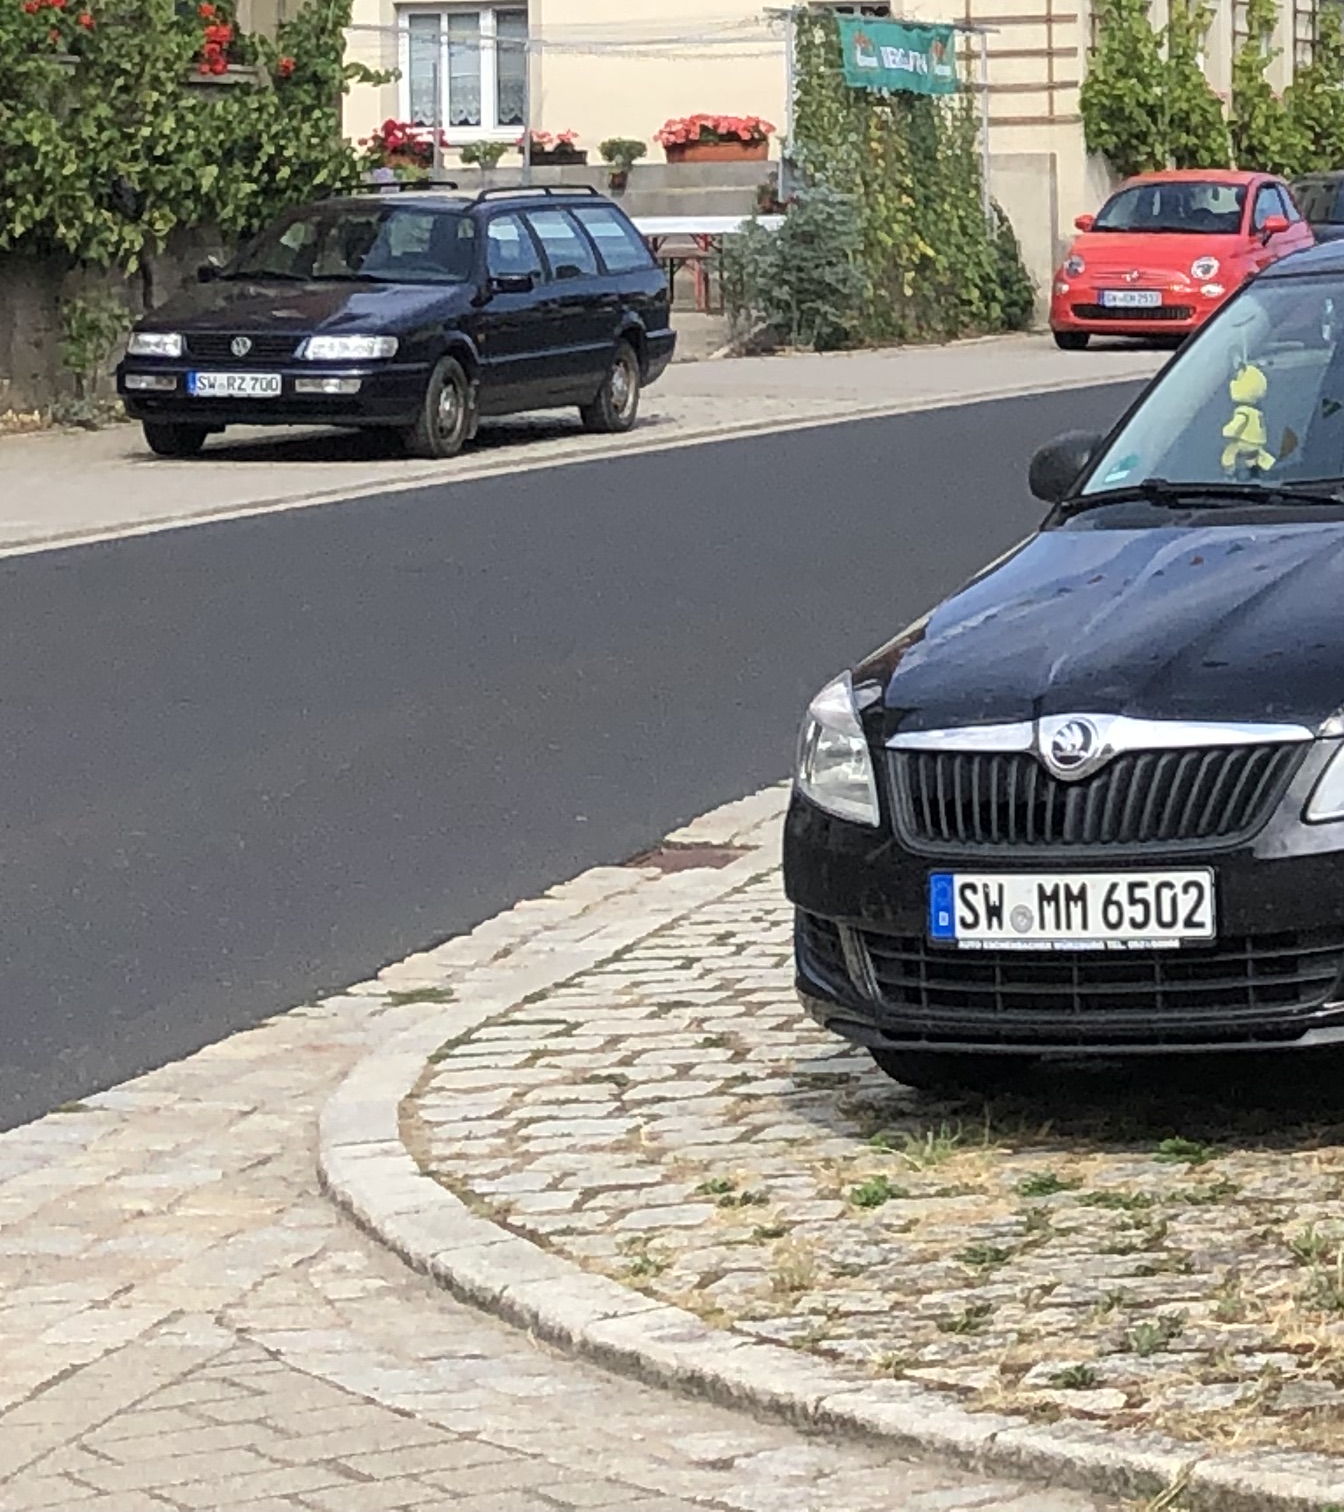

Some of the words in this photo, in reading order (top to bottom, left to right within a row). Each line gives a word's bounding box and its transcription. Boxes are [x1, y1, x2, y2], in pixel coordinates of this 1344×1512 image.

[197, 375, 217, 391] SW
[226, 375, 247, 392] RZ
[250, 377, 279, 392] 700
[958, 882, 1004, 931] SW
[1037, 882, 1089, 931] MM
[1101, 879, 1206, 931] 6502
